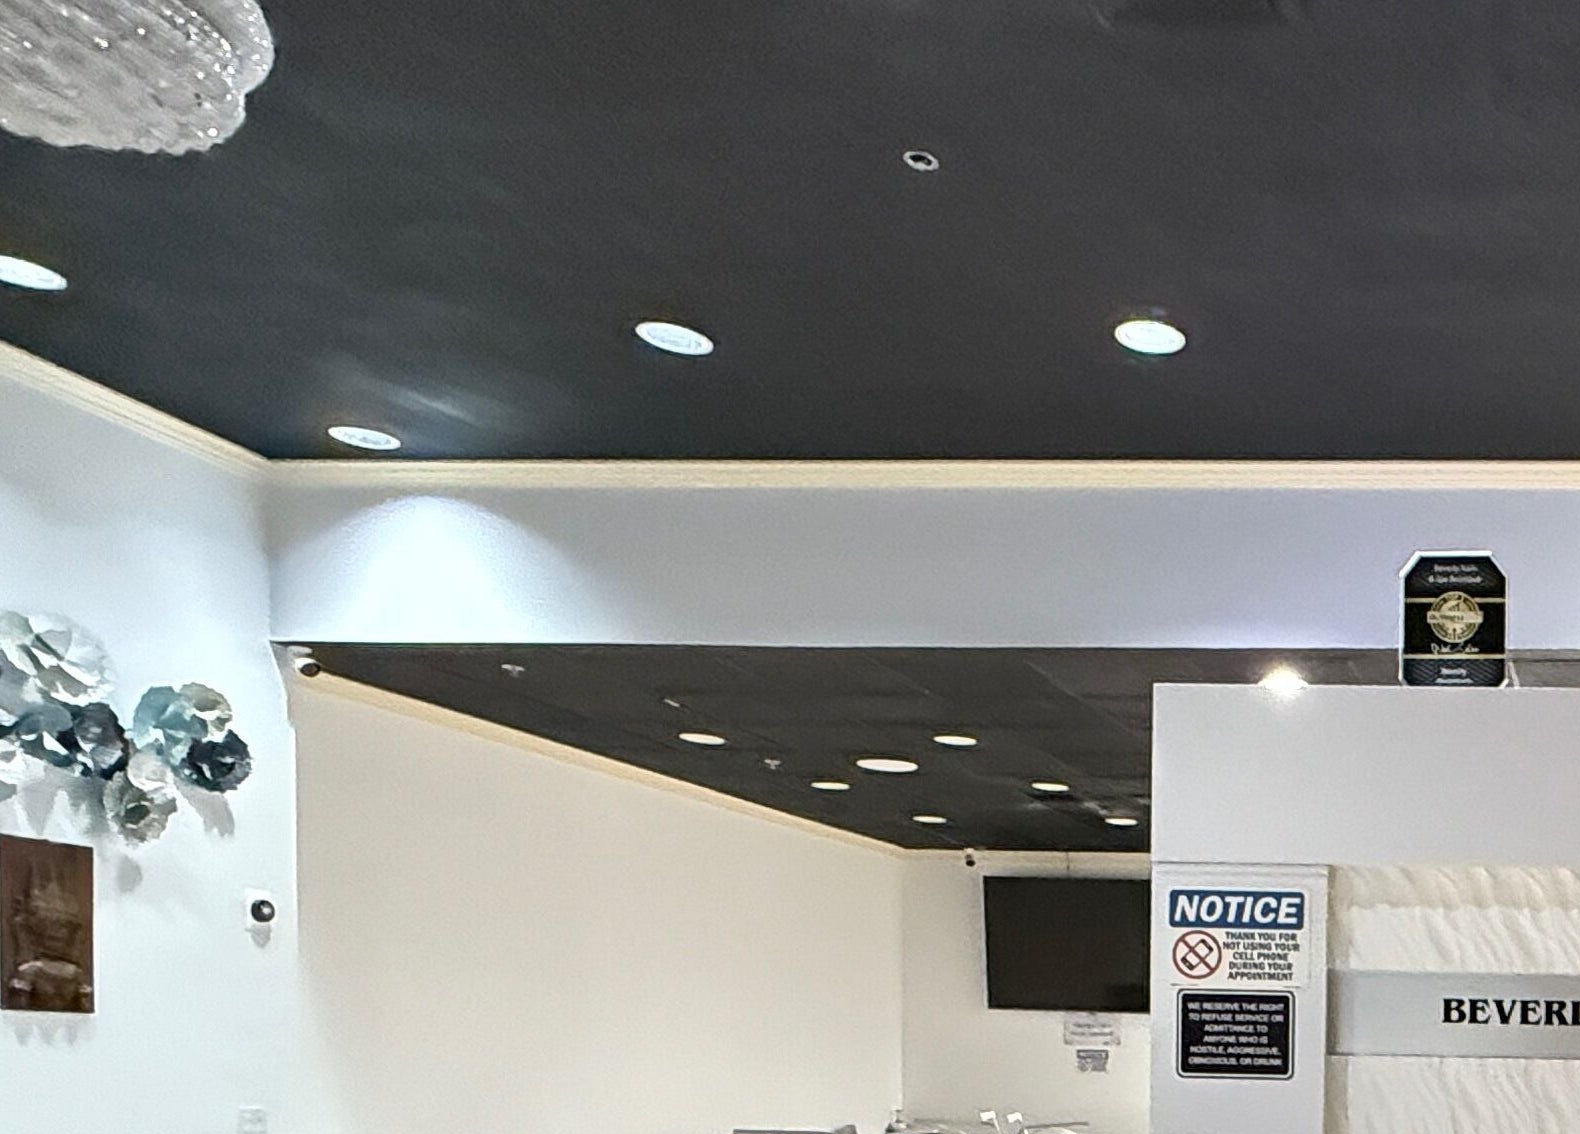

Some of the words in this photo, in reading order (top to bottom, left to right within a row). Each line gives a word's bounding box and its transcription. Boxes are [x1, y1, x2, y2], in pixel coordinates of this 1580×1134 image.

[1173, 893, 1301, 925] NOTICE
[1225, 931, 1256, 940] THANK
[1257, 932, 1276, 941] YOU
[1279, 933, 1297, 941] FOR
[1222, 942, 1240, 950] NOT
[1242, 942, 1272, 951] USING
[1274, 943, 1300, 952] YOUR
[1232, 951, 1255, 961] CELL
[1257, 952, 1289, 962] PHONE
[1228, 961, 1266, 971] DURING
[1267, 962, 1294, 971] YOUR
[1227, 971, 1294, 981] APPOINTMENT
